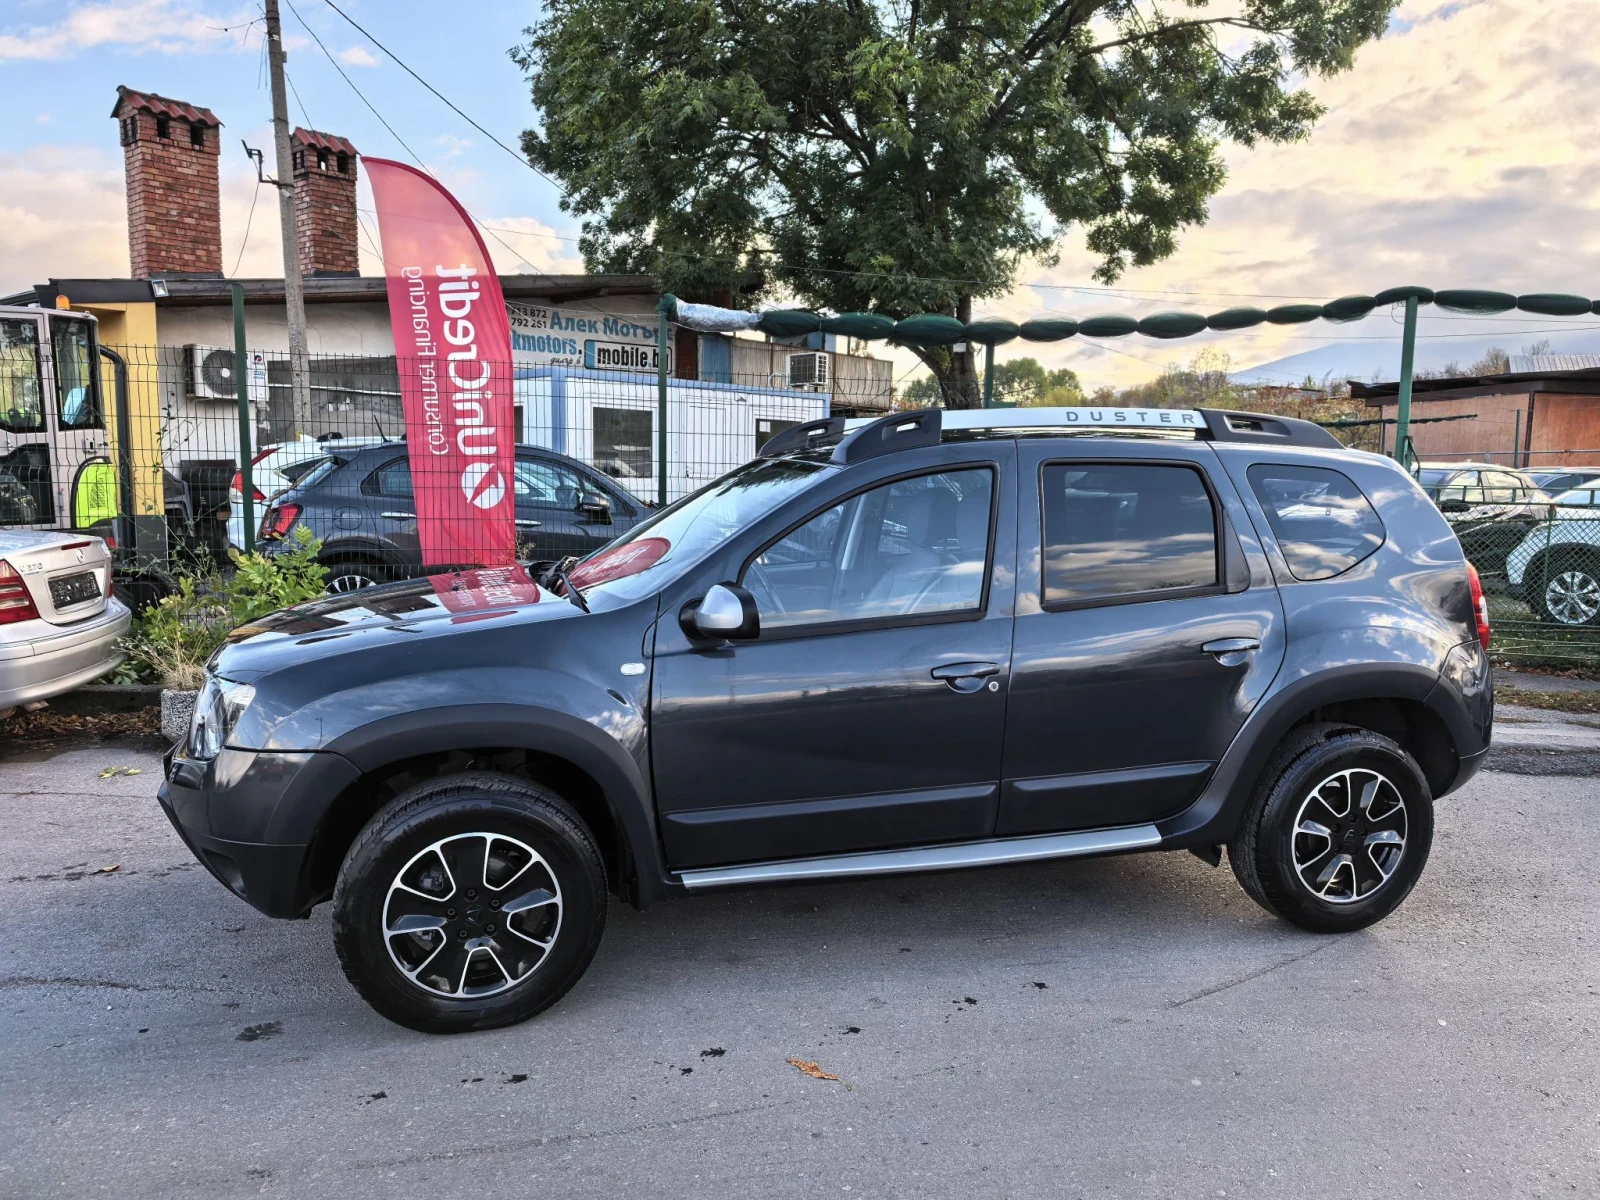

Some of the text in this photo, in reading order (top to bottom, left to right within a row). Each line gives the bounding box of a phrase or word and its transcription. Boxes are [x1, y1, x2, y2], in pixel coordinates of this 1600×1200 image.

[511, 317, 529, 327] 792
[530, 308, 547, 319] 872
[550, 311, 599, 334] Алек
[510, 331, 582, 356] kmotors.
[597, 346, 669, 369] mobile.b
[1065, 411, 1195, 424] DUSTER
